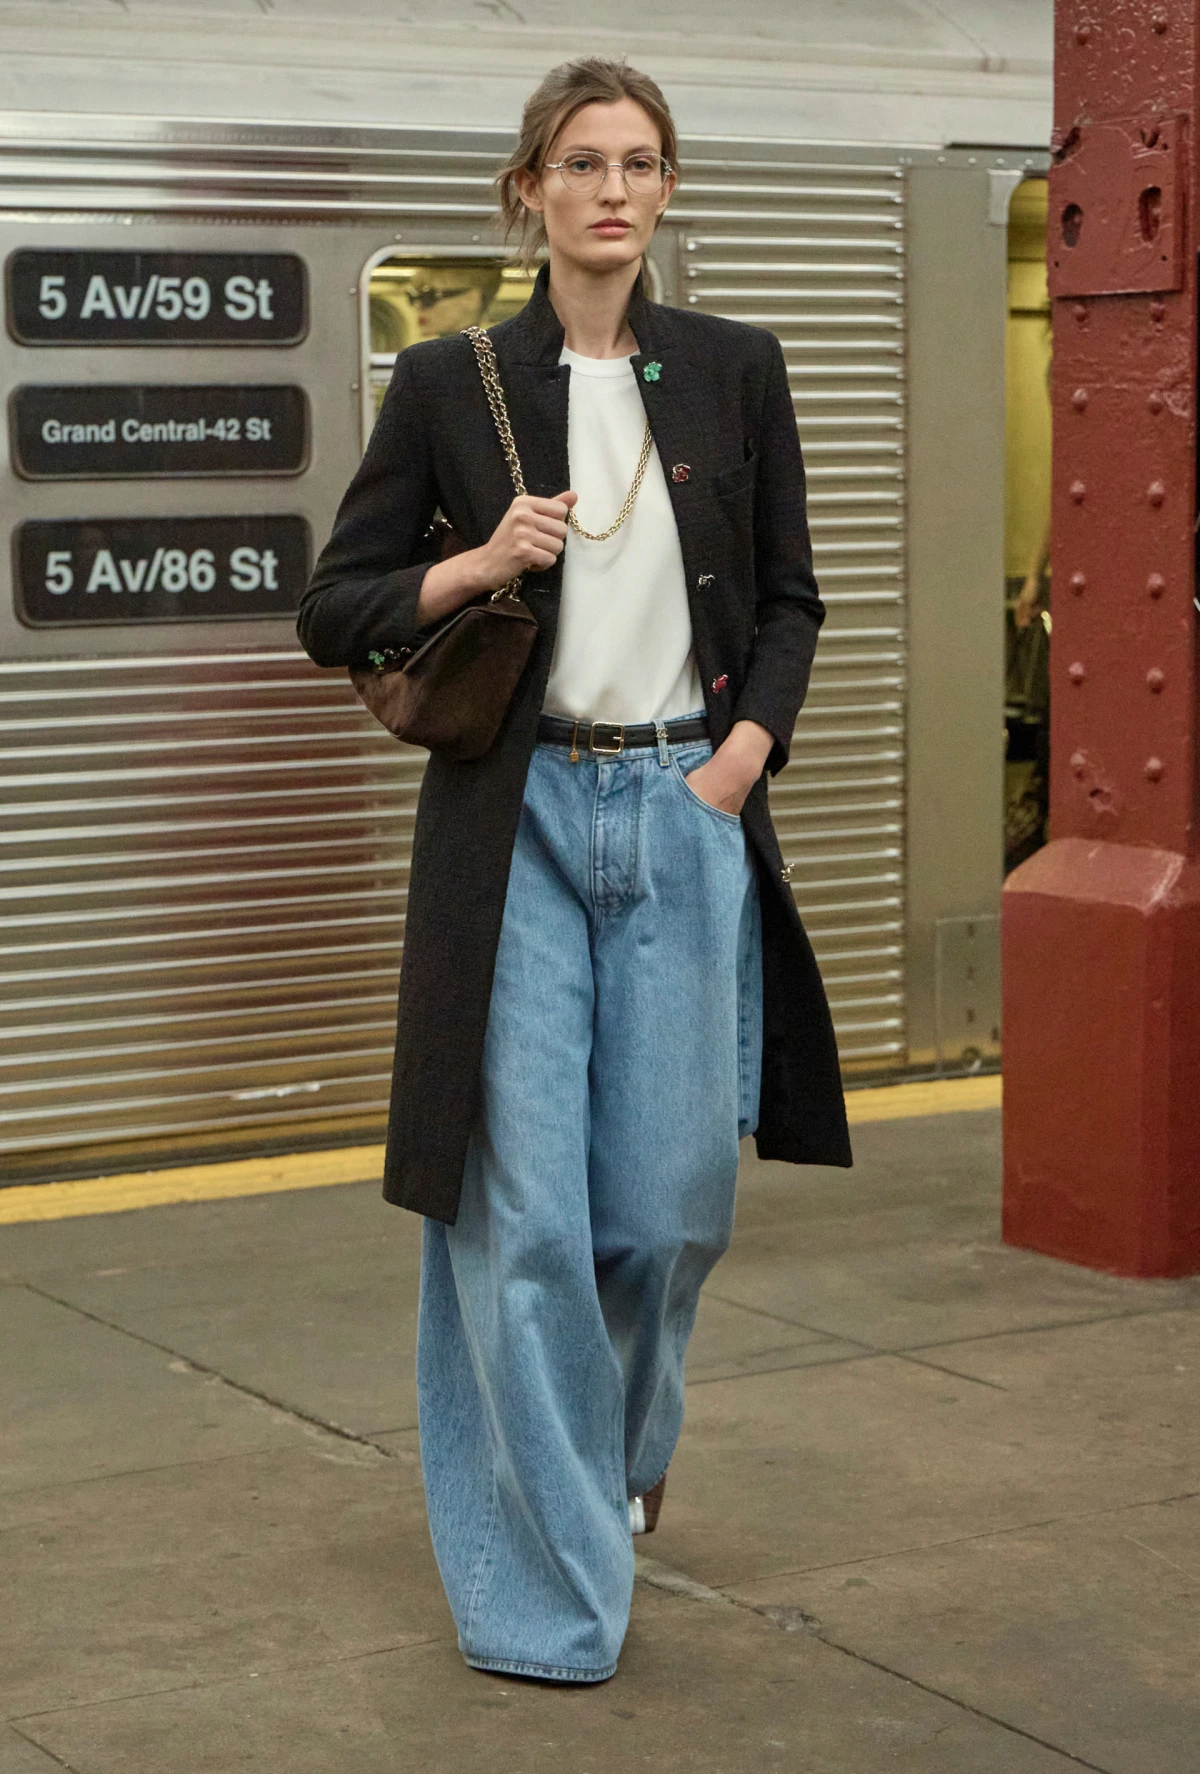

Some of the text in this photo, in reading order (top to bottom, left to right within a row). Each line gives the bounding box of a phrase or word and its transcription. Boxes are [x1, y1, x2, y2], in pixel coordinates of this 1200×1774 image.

[39, 274, 274, 321] 5 Av/59 St
[41, 417, 271, 443] Grand Central-42 St
[45, 547, 278, 594] 5 Av/86 St
